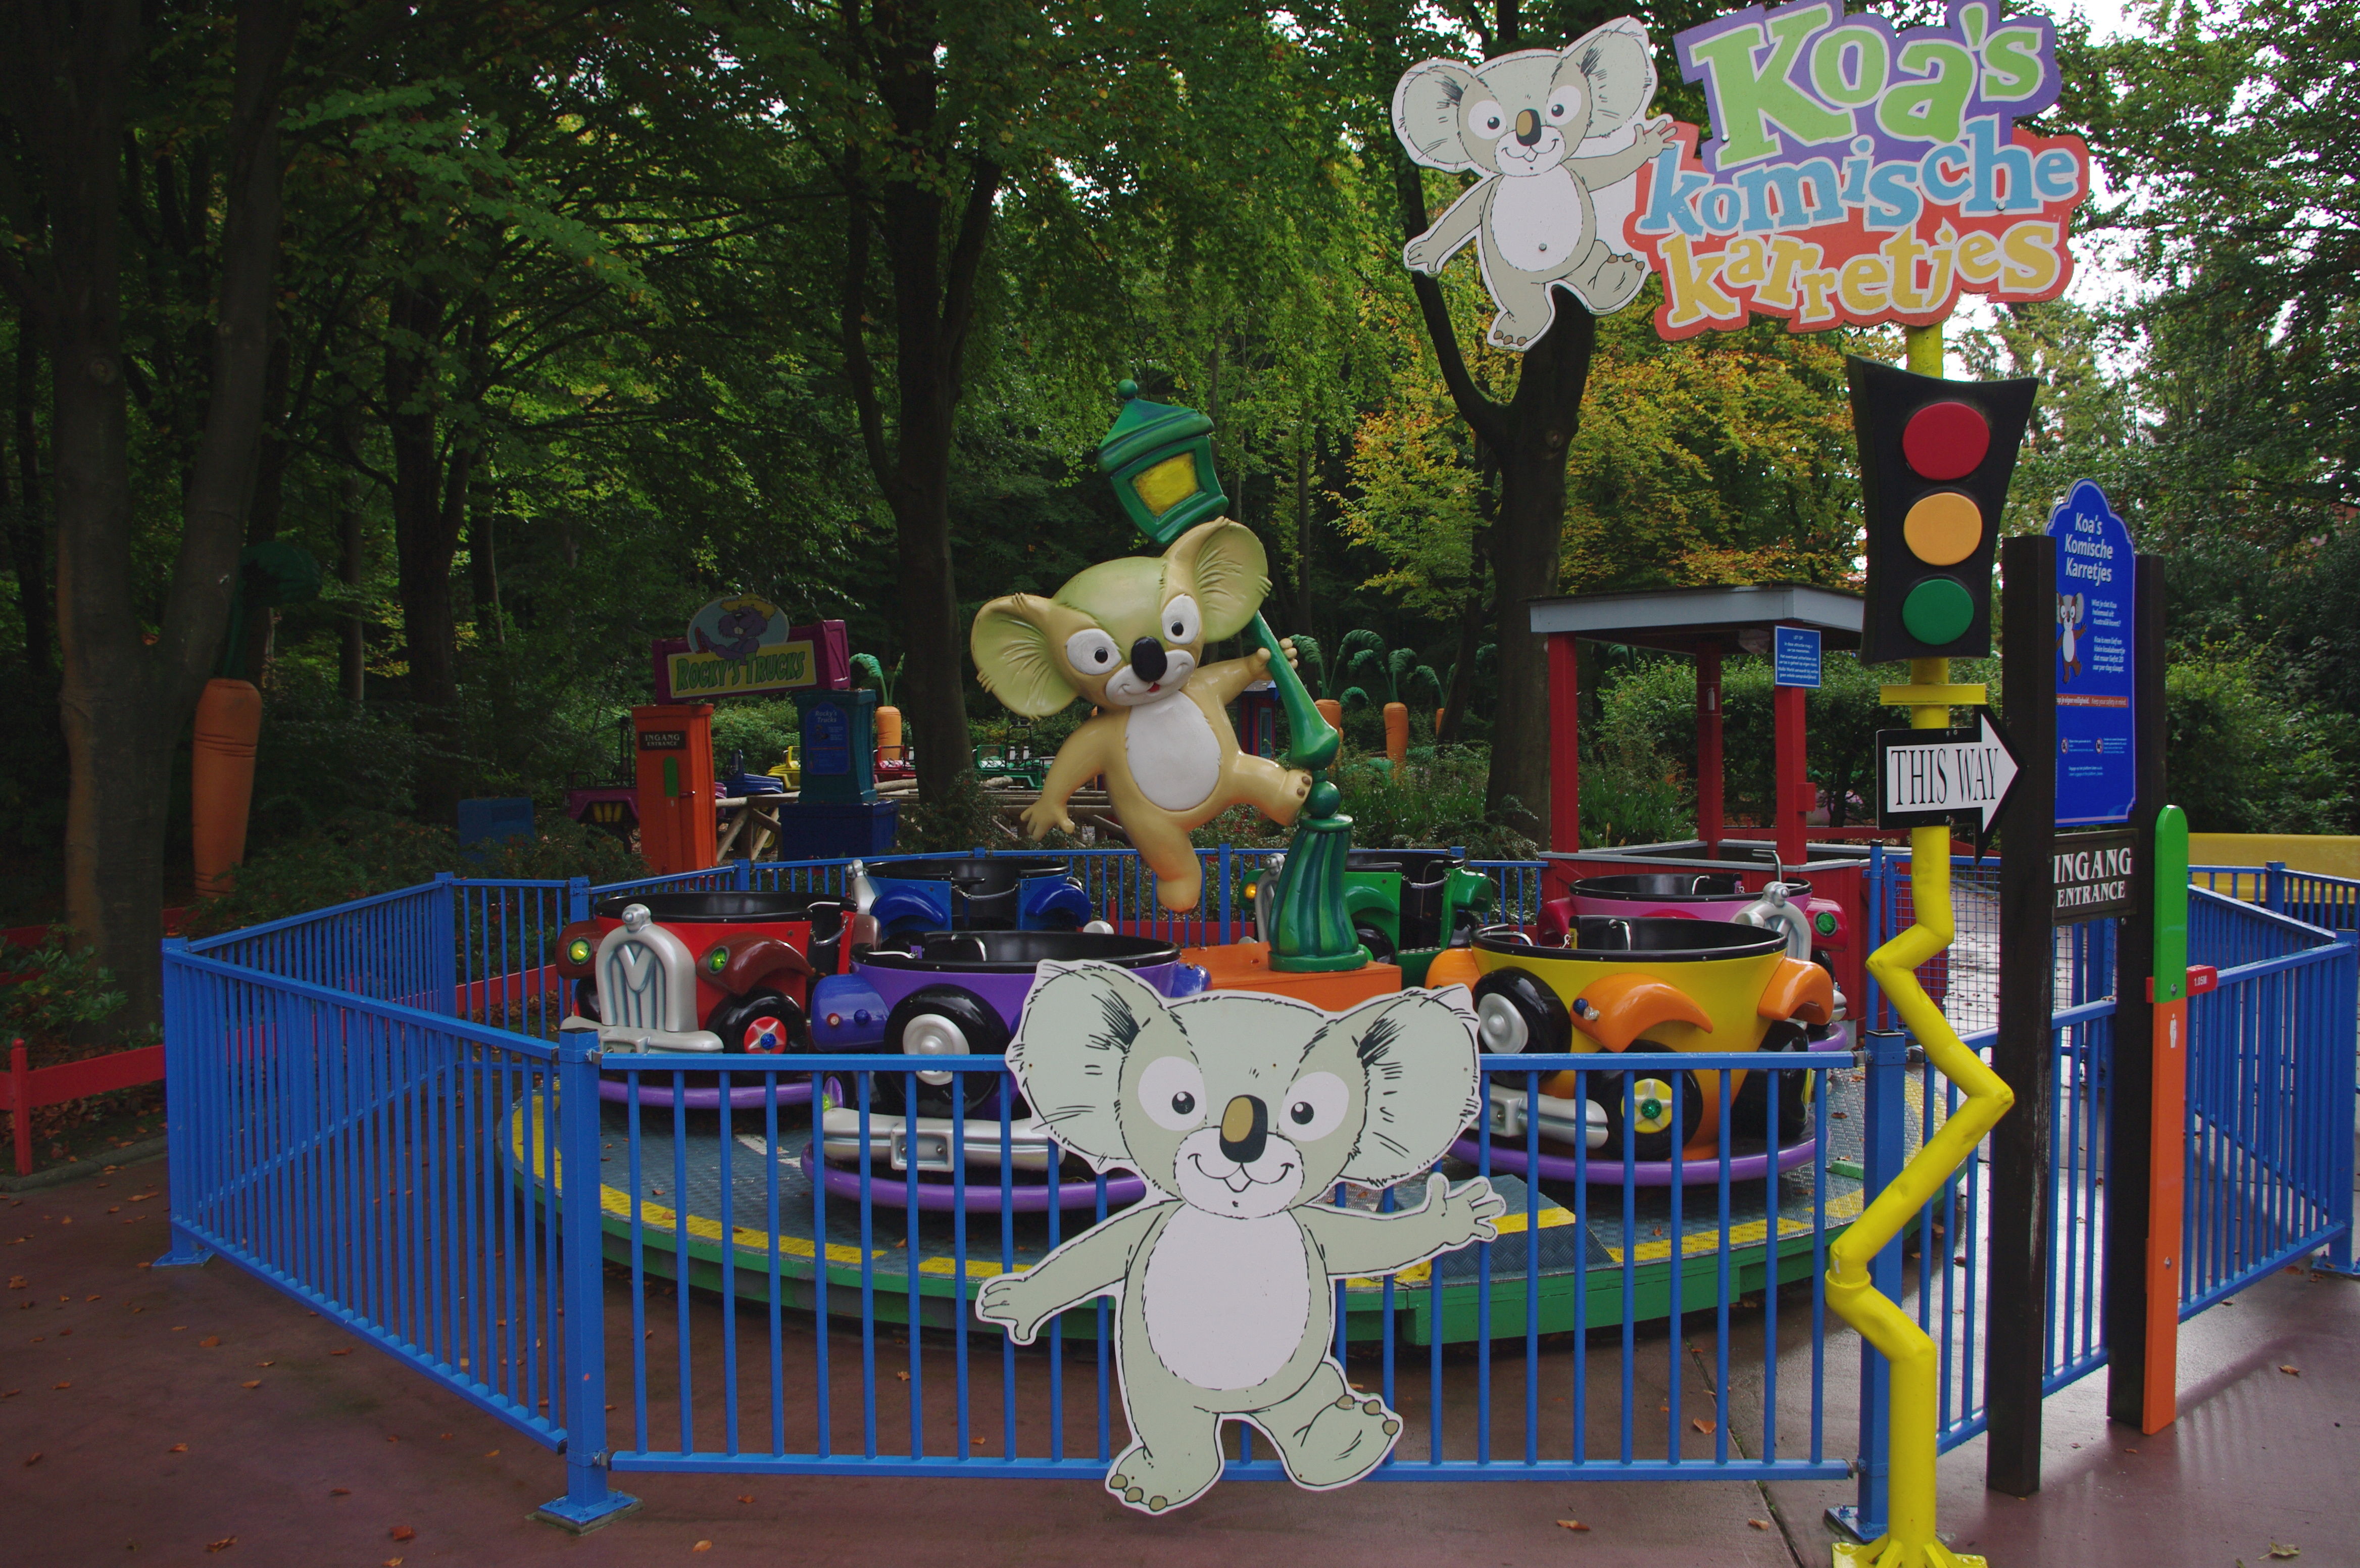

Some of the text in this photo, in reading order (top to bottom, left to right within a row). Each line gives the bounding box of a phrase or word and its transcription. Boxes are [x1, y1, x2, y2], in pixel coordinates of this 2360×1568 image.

[1692, 2, 2043, 169] Koa's
[1638, 115, 2080, 236] komische
[1659, 219, 2061, 327] karretjes
[2075, 512, 2102, 535] Koa's
[2064, 533, 2113, 560] Komische
[2065, 557, 2112, 586] Karretjes
[676, 652, 805, 692] ROCKY'S TRUCKS
[645, 733, 680, 742] INGANG
[1891, 748, 1947, 805] THIS
[1955, 747, 1998, 803] WAY
[2053, 847, 2133, 884] INGANG
[1024, 880, 1030, 891] 3
[2056, 880, 2126, 908] ENTRANCE
[2194, 975, 2207, 987] 1.05M
